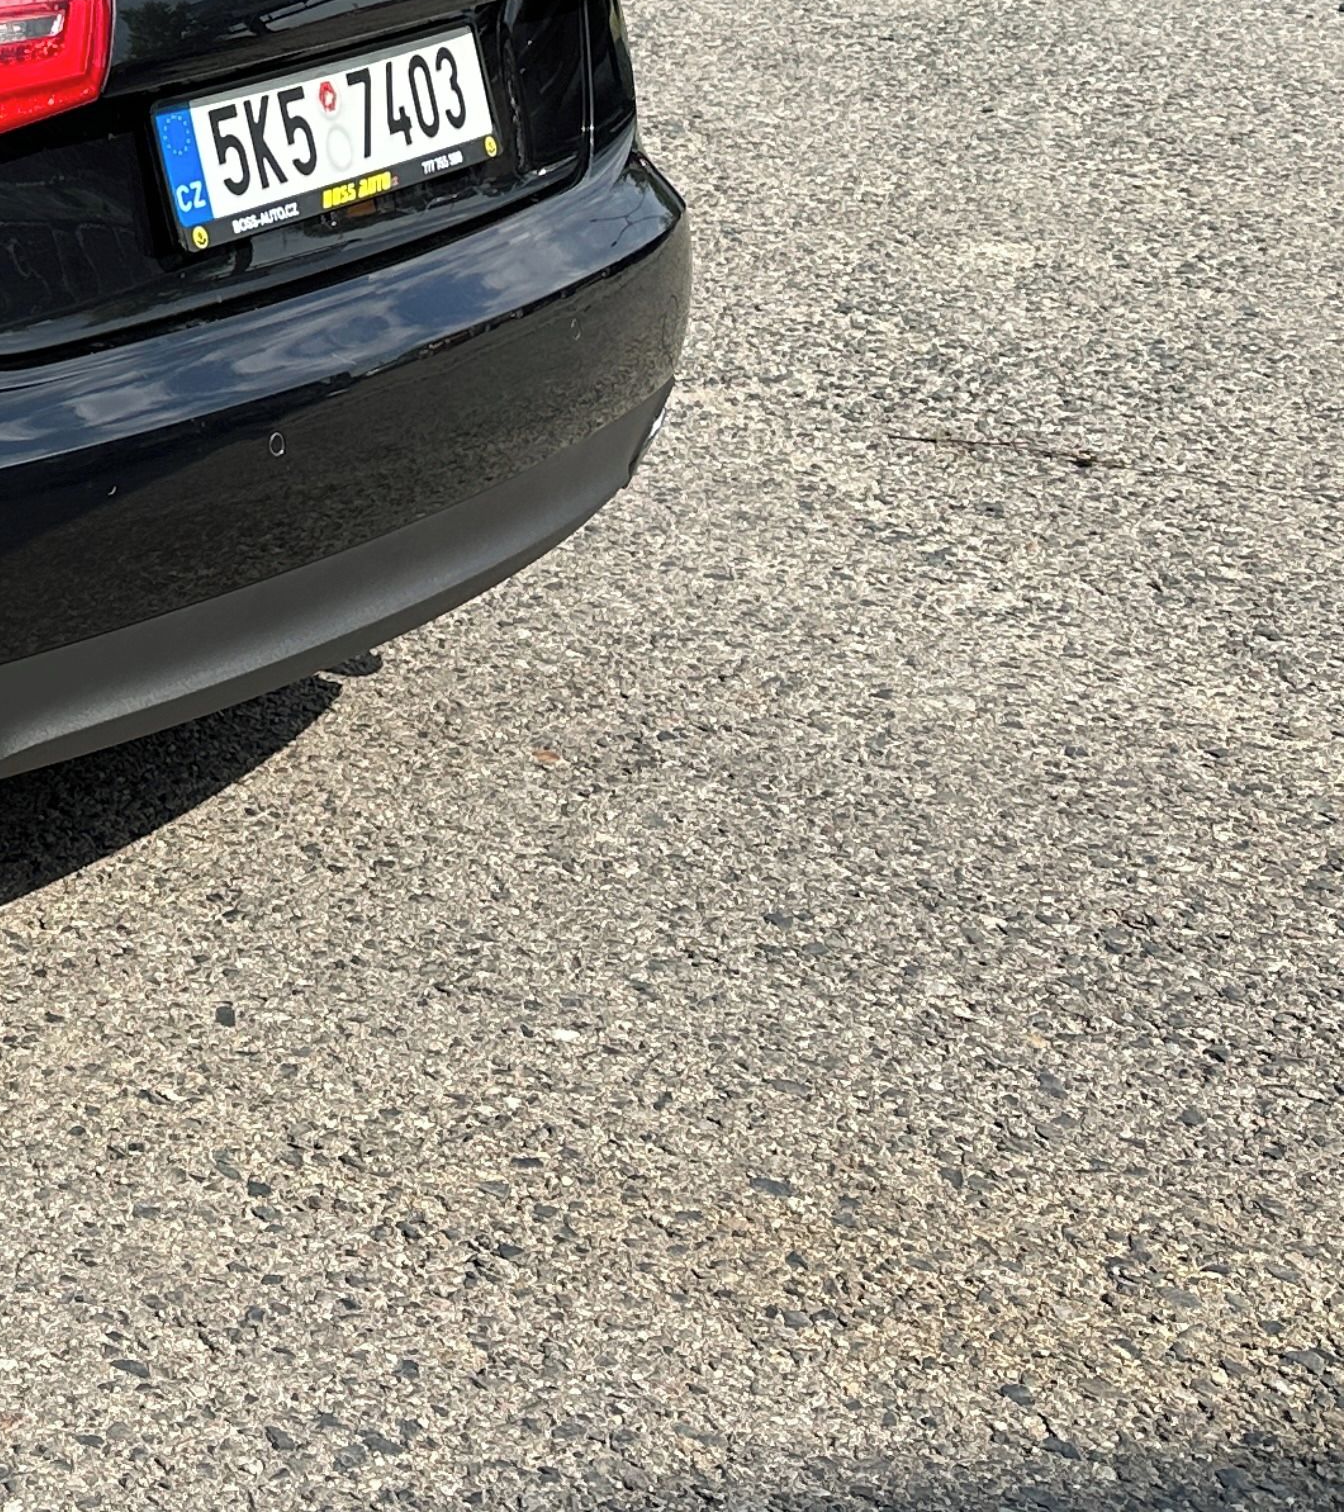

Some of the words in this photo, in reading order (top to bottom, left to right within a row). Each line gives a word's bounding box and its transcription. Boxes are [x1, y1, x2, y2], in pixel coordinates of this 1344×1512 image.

[208, 86, 317, 196] 5K5
[345, 46, 466, 158] 7403
[175, 180, 207, 213] CZ
